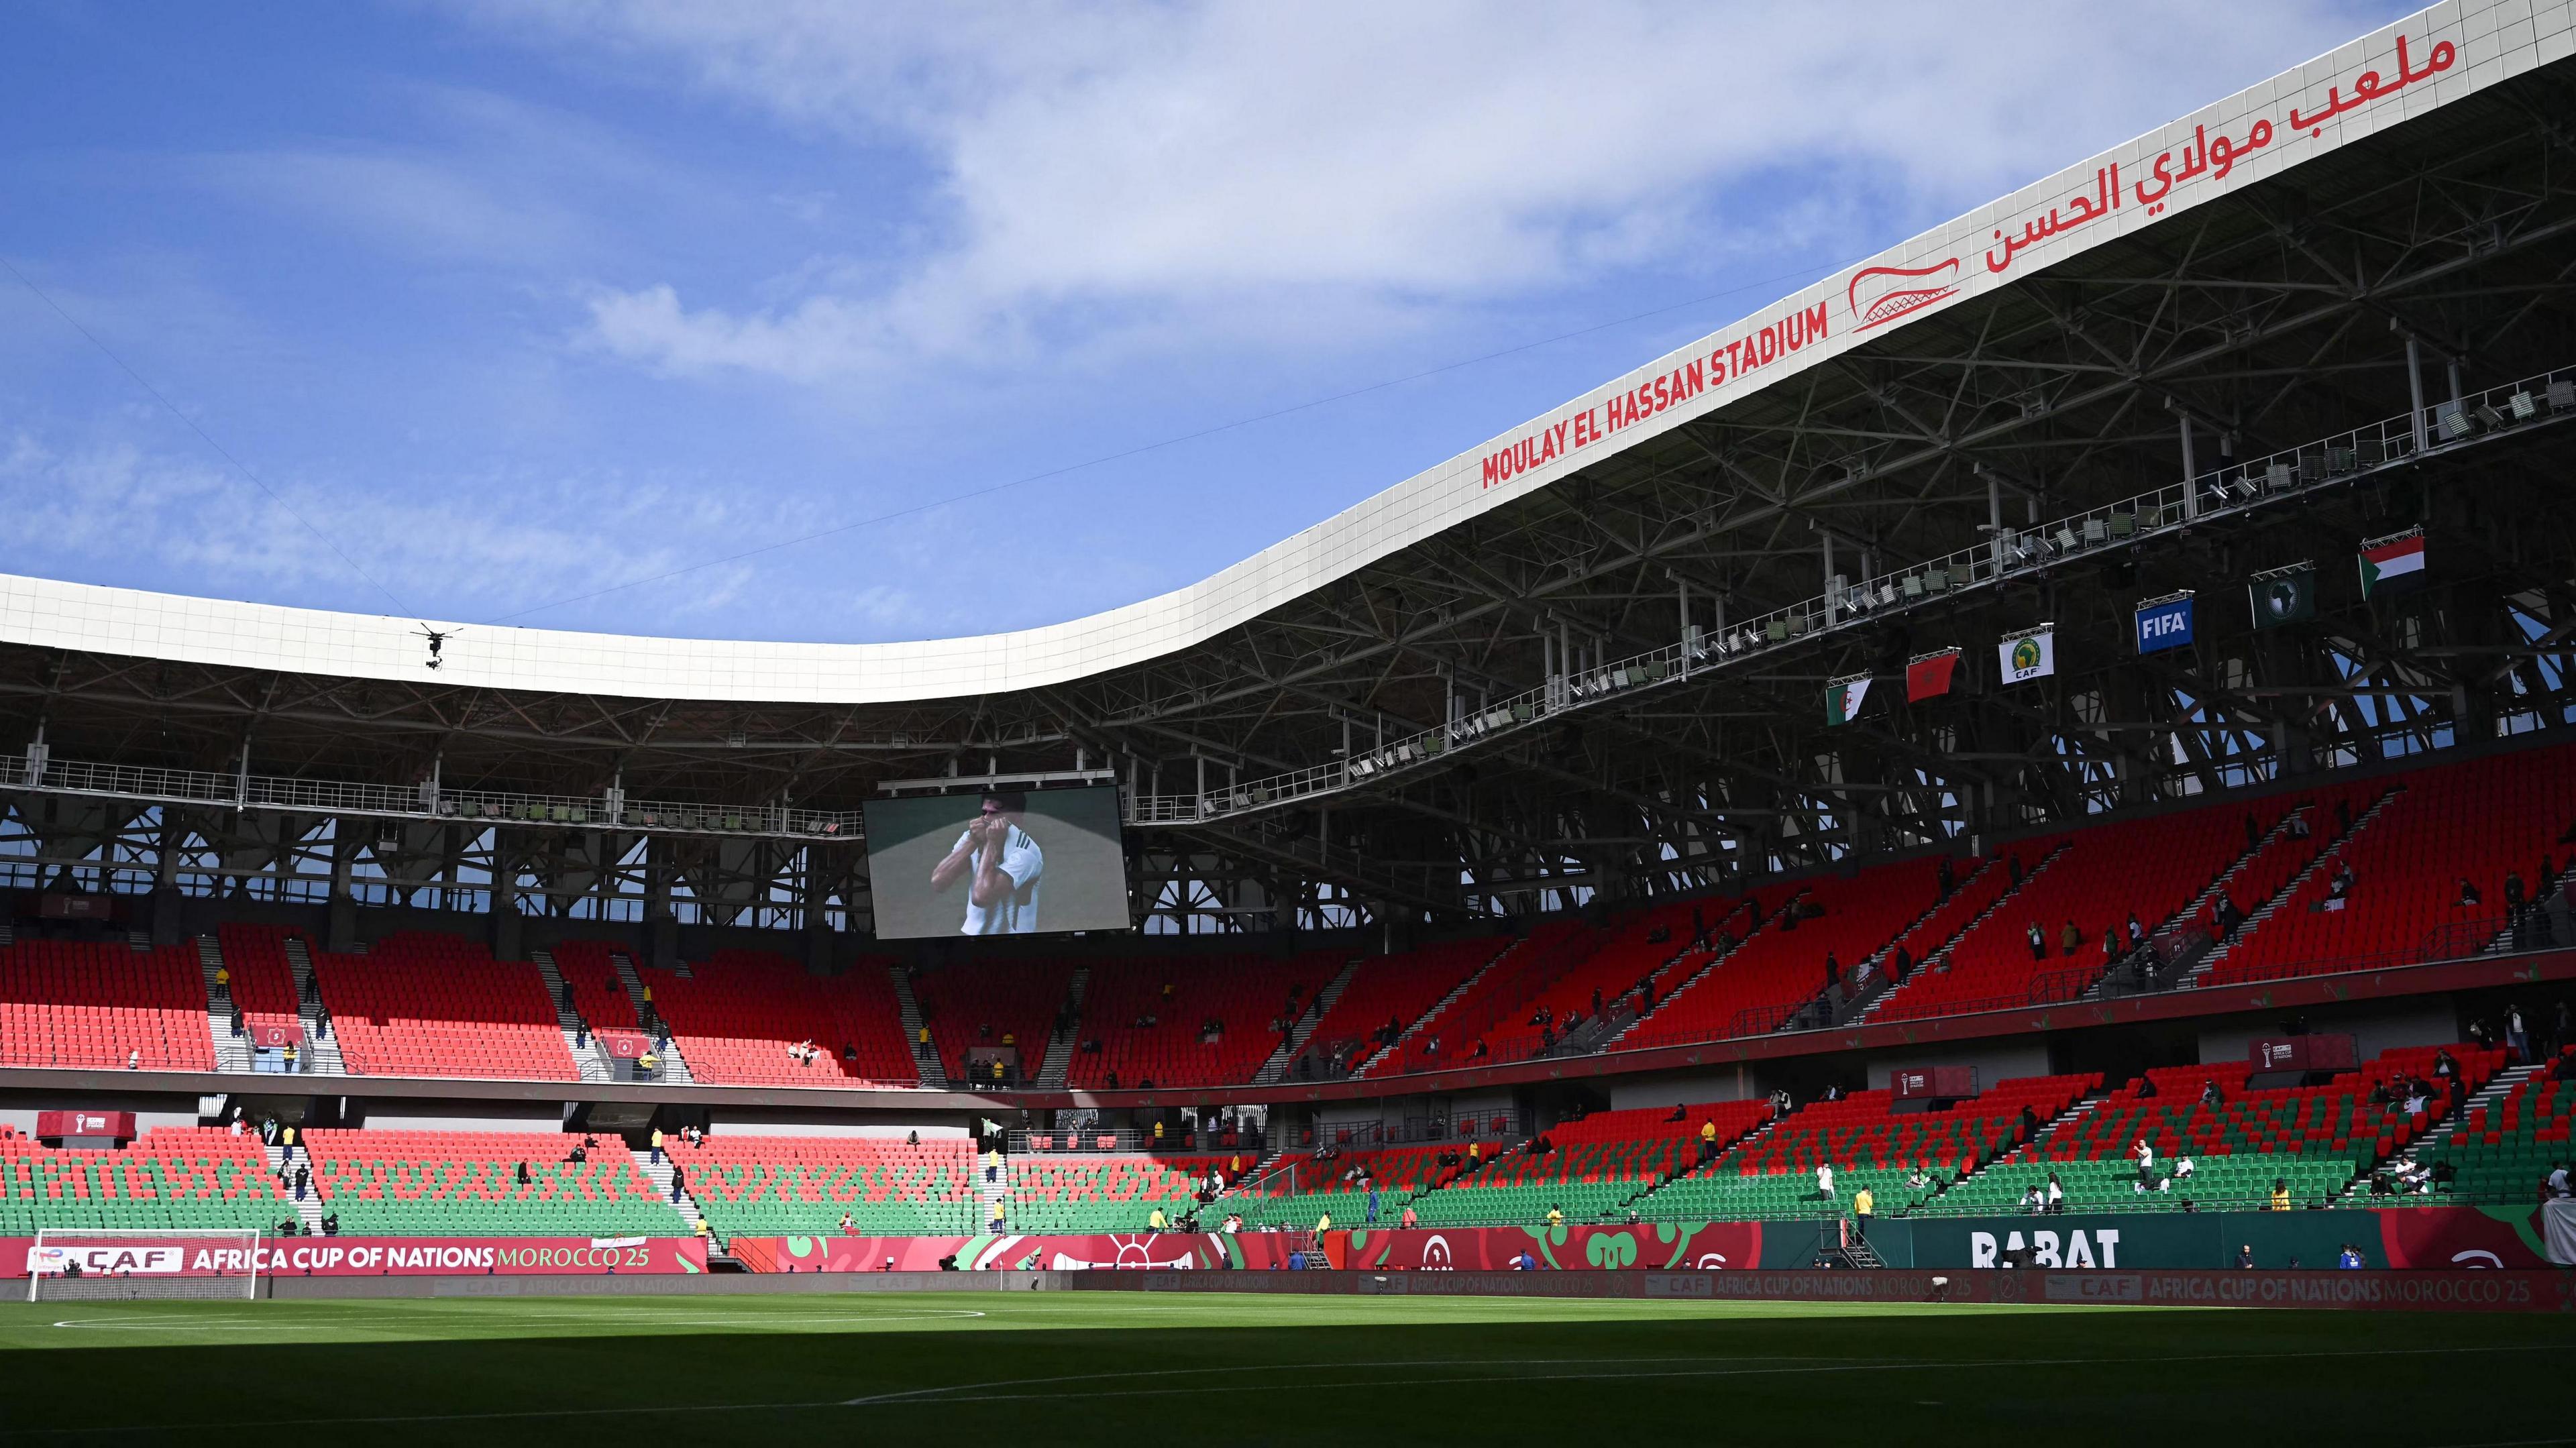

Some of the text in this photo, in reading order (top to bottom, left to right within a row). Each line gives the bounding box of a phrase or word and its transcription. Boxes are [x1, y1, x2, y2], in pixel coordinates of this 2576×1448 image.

[1987, 36, 2455, 272] ملعب مولاي الحسن
[1483, 302, 1827, 488] MOULAY EL HASSAN STADIUM
[2143, 612, 2185, 639] FIFA
[2016, 668, 2037, 679] CAF
[193, 1247, 649, 1269] AFRICA CUP OF NATIONS MOROCCO 25
[1972, 1229, 2119, 1268] RABAT
[88, 1251, 165, 1268] CAF
[1377, 1277, 1403, 1290] AF
[1670, 1277, 1705, 1292] CAF
[1717, 1277, 1972, 1296] AFRICA CUP OF NATIONS MOROCO 25
[2081, 1278, 2130, 1296] CAF
[2149, 1278, 2530, 1302] AFRICA CUP OF NATIONS MOROCCO 25
